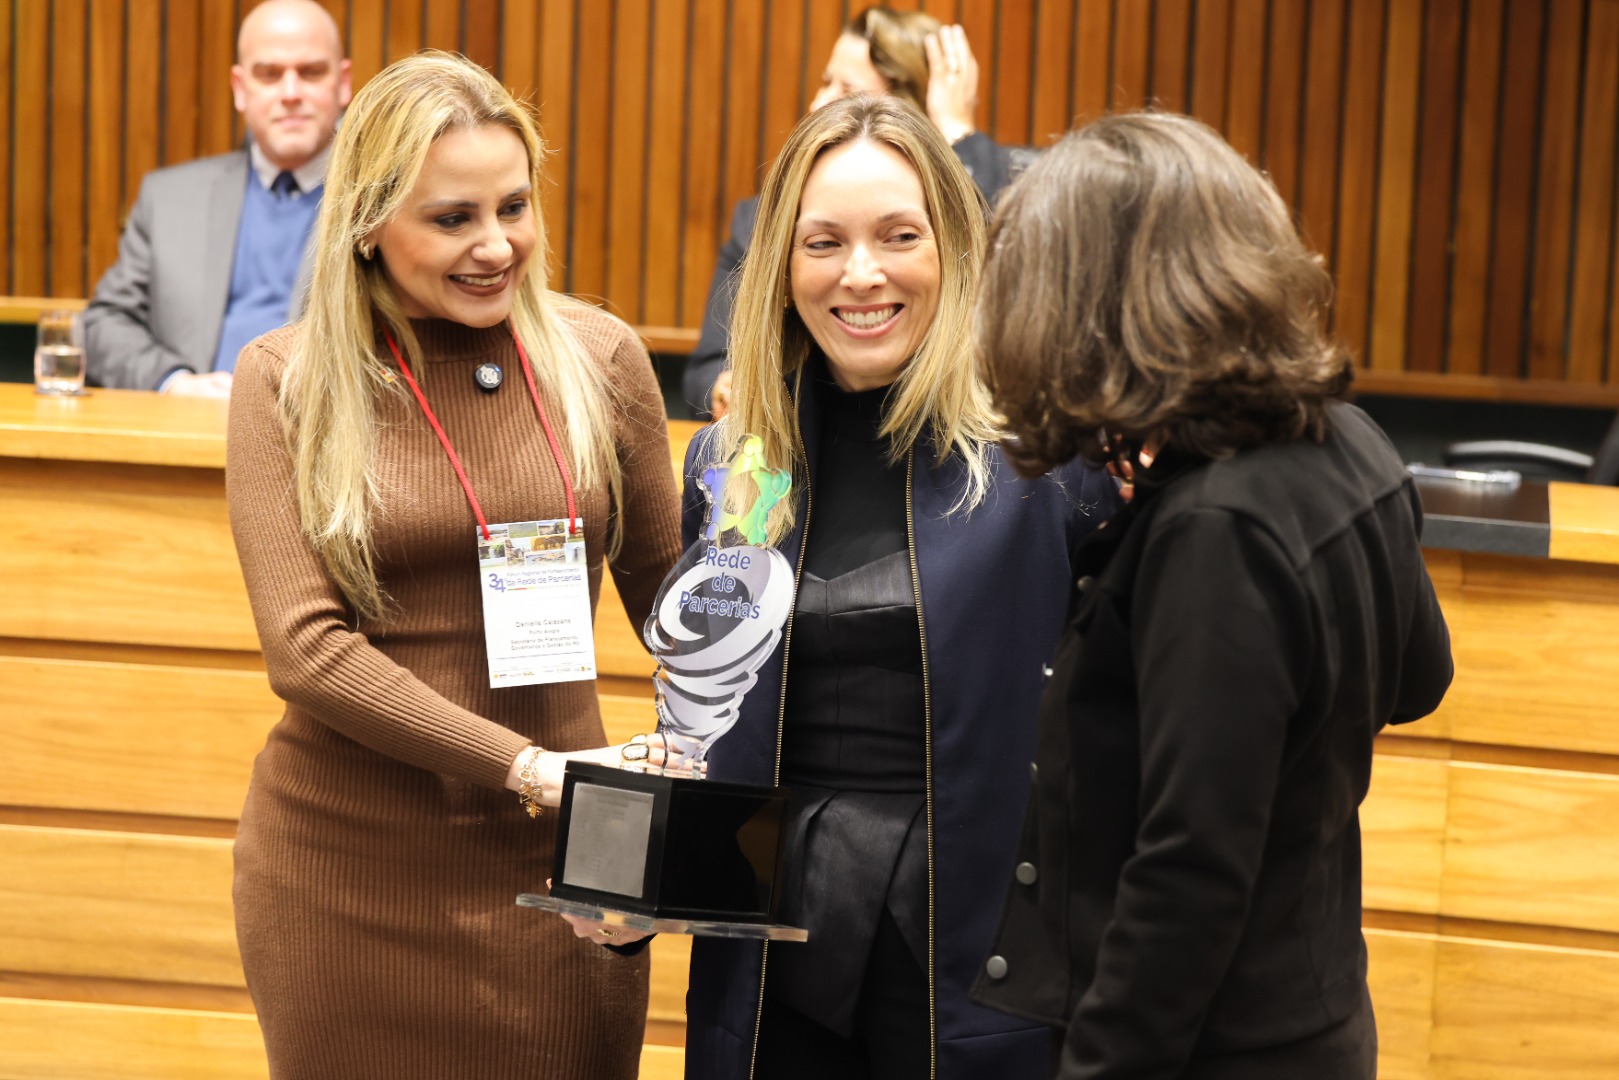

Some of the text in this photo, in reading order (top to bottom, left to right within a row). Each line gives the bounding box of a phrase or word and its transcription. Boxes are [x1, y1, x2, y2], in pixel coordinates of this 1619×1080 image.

[705, 546, 751, 570] Rede
[517, 577, 537, 586] Rede
[538, 576, 547, 584] de
[548, 573, 582, 583] Parcerias
[711, 572, 736, 593] de
[679, 590, 761, 620] Parcerias
